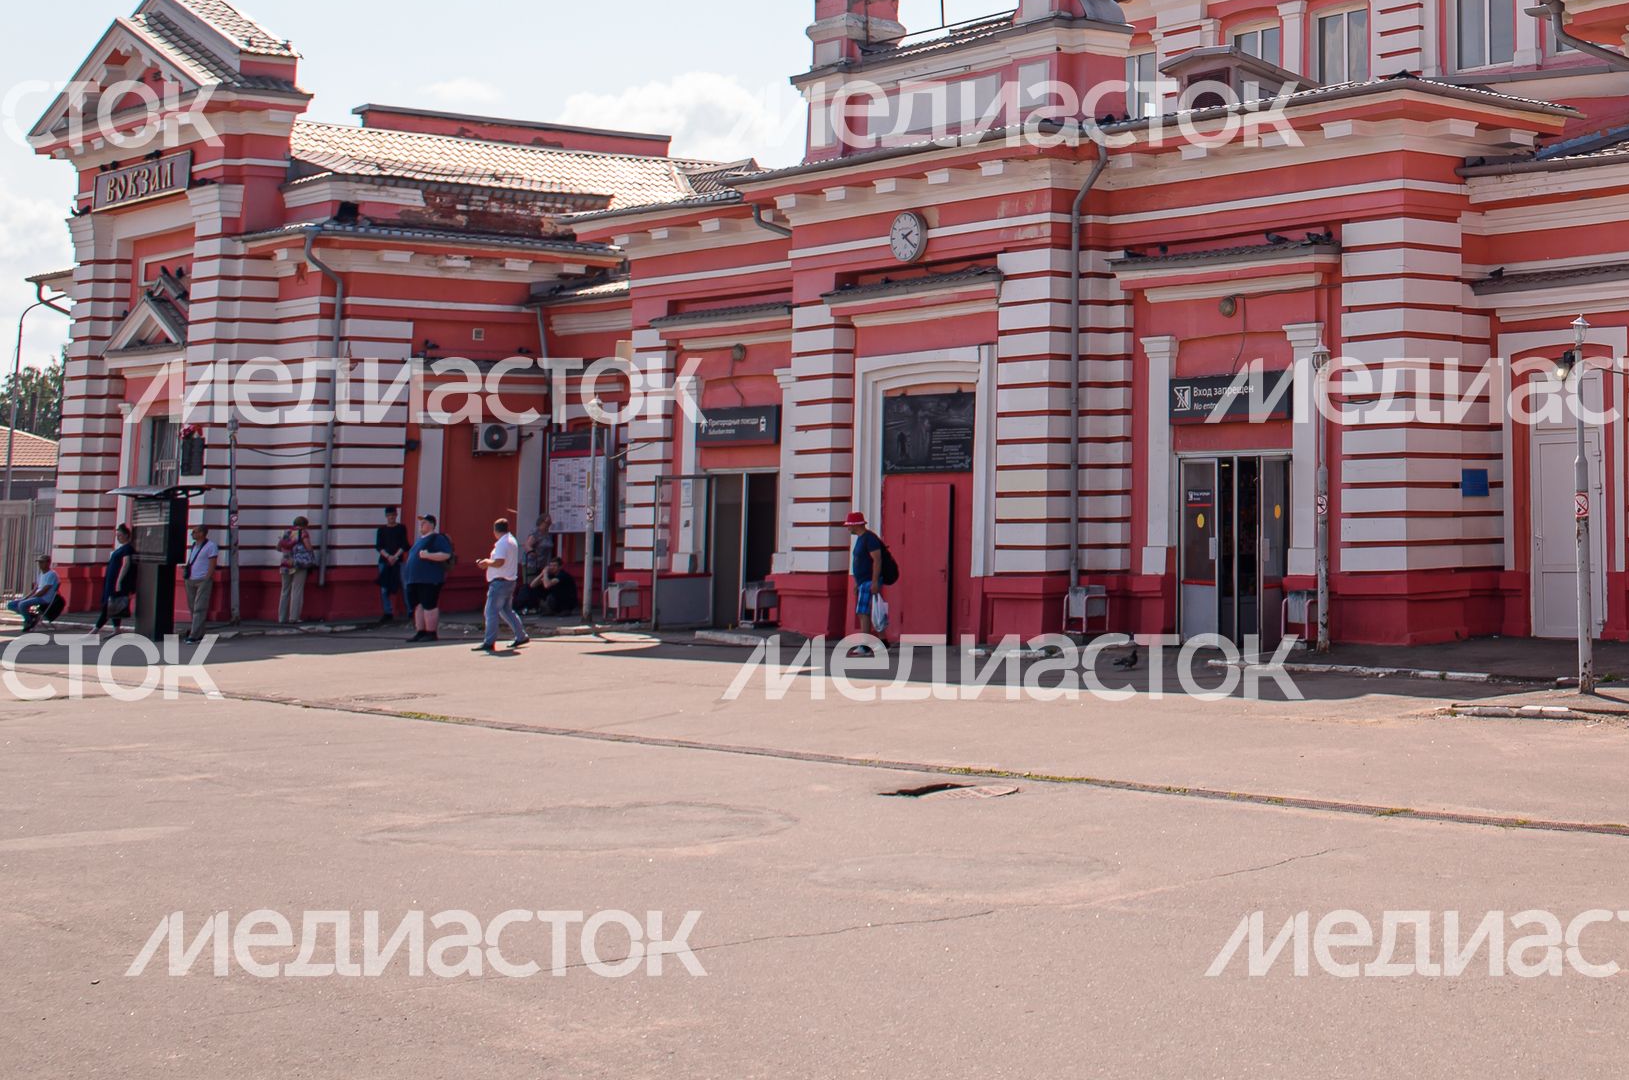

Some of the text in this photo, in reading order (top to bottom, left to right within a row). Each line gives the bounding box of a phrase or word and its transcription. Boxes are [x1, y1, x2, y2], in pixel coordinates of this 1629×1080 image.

[106, 162, 175, 203] ВОКЗАЛ
[1193, 385, 1254, 397] Вход запрещен
